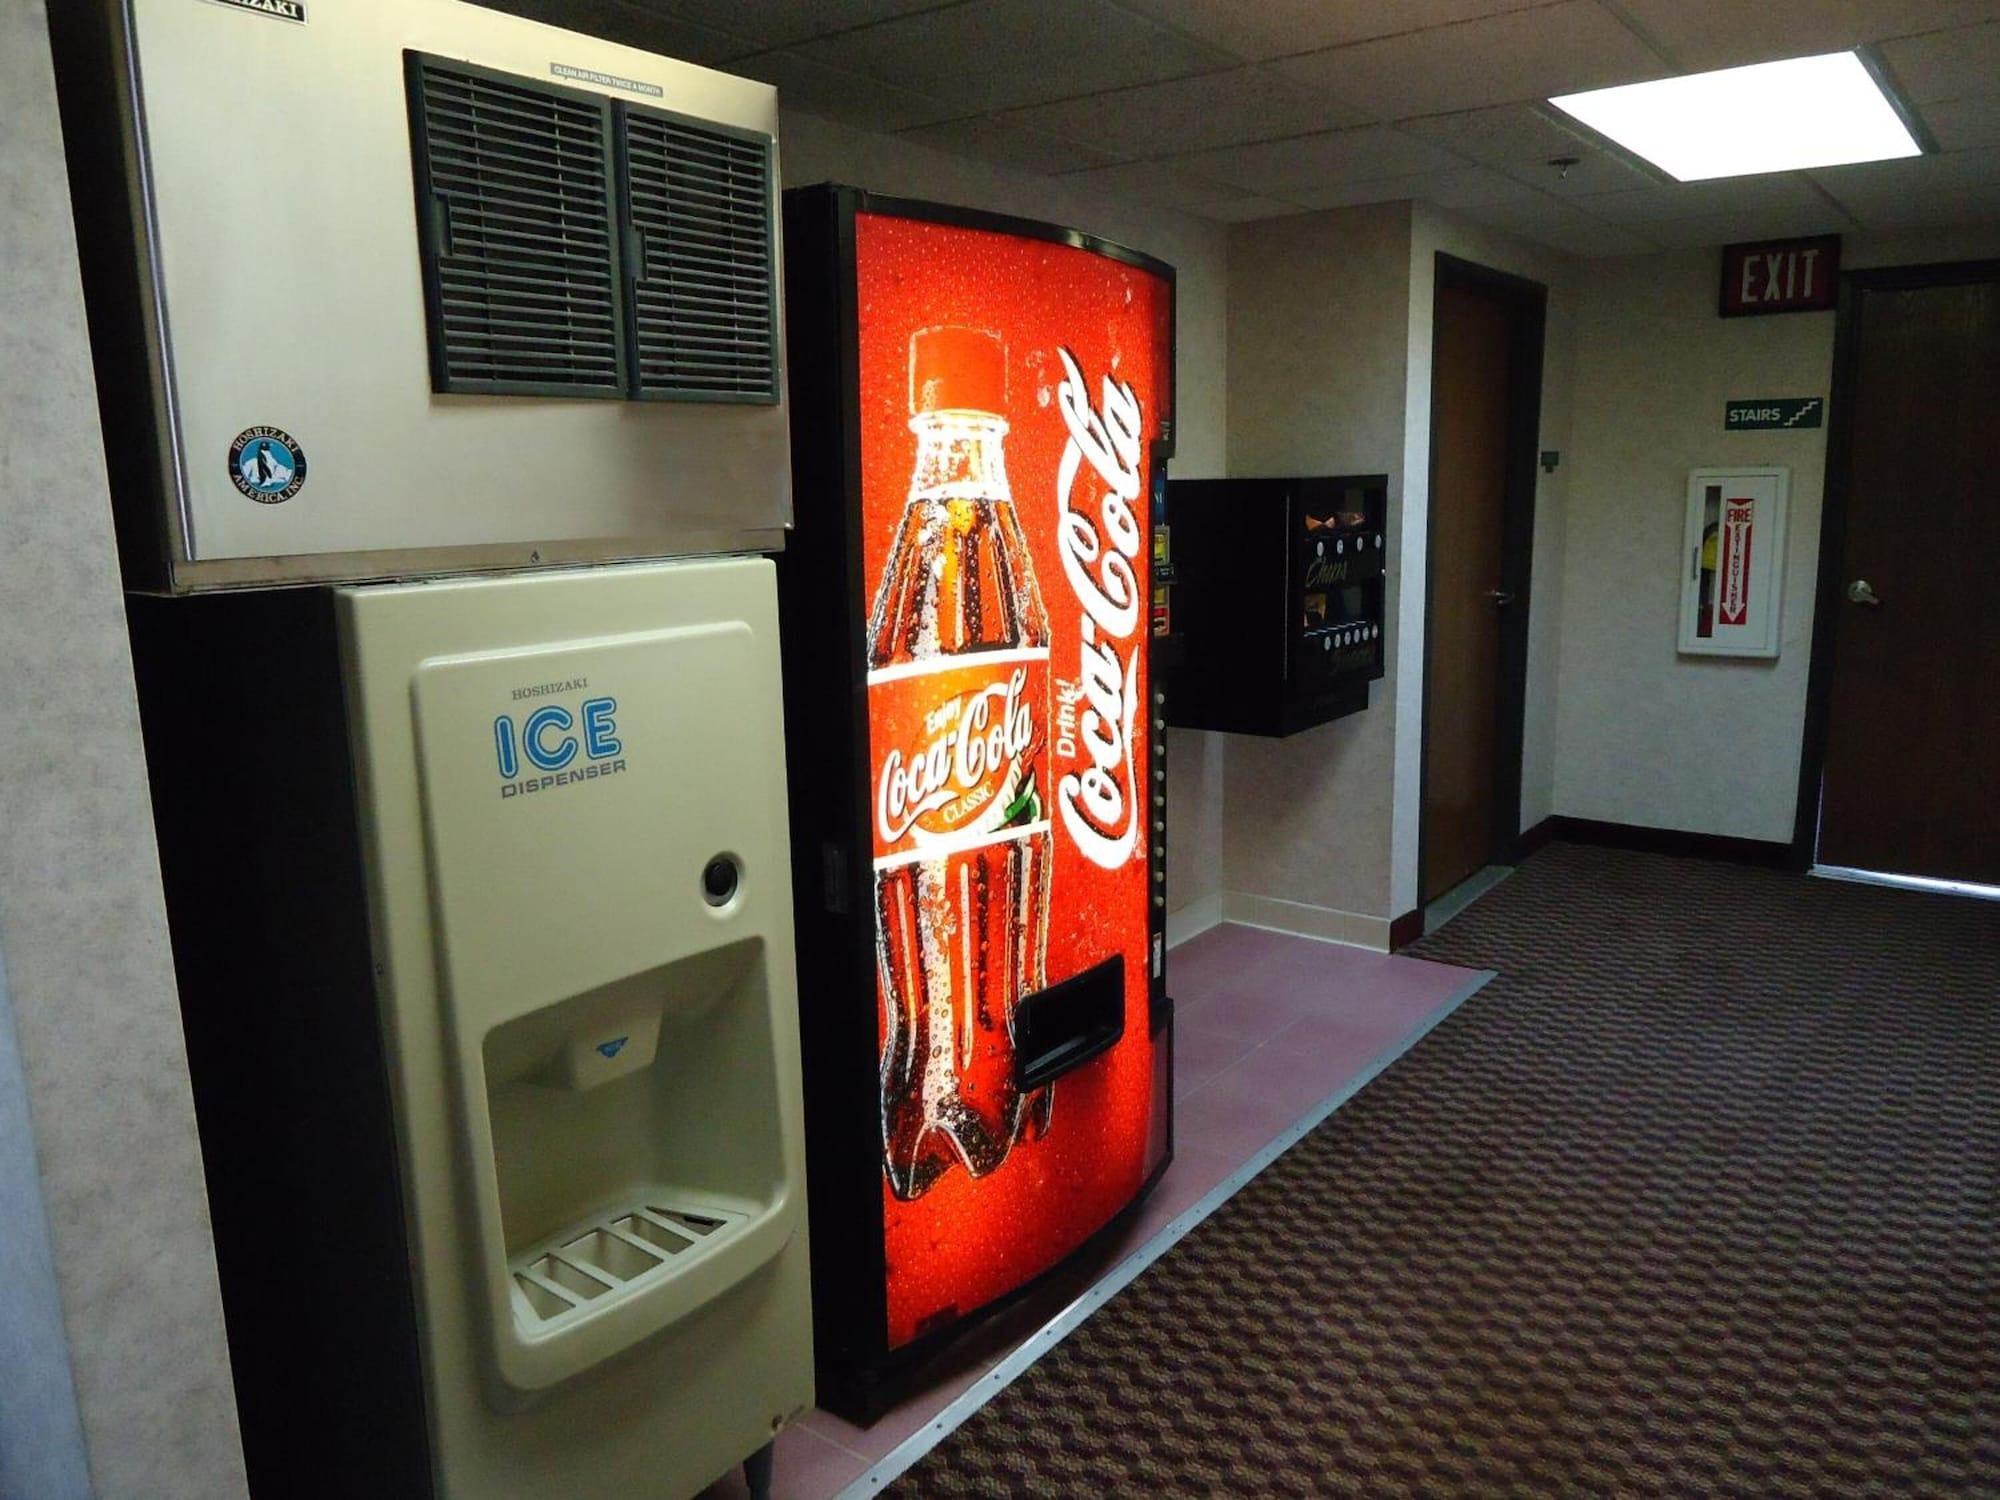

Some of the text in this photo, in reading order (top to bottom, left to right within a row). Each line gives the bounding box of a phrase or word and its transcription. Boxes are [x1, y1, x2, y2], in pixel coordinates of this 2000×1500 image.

[1741, 250, 1819, 303] EXIT
[1729, 408, 1781, 422] STAIRS
[233, 427, 299, 452] HOSHIZAKI
[1727, 508, 1751, 522] FIRE
[1729, 523, 1743, 613] EXTINGUISHER
[1057, 346, 1142, 869] Coca-Cola
[511, 678, 589, 700] HOSHIZAKI
[925, 696, 963, 734] Enjoy
[494, 697, 622, 779] ICE
[877, 664, 1033, 844] Coca-Cola
[501, 759, 627, 799] DISPENSER
[942, 781, 996, 824] CLASSIC
